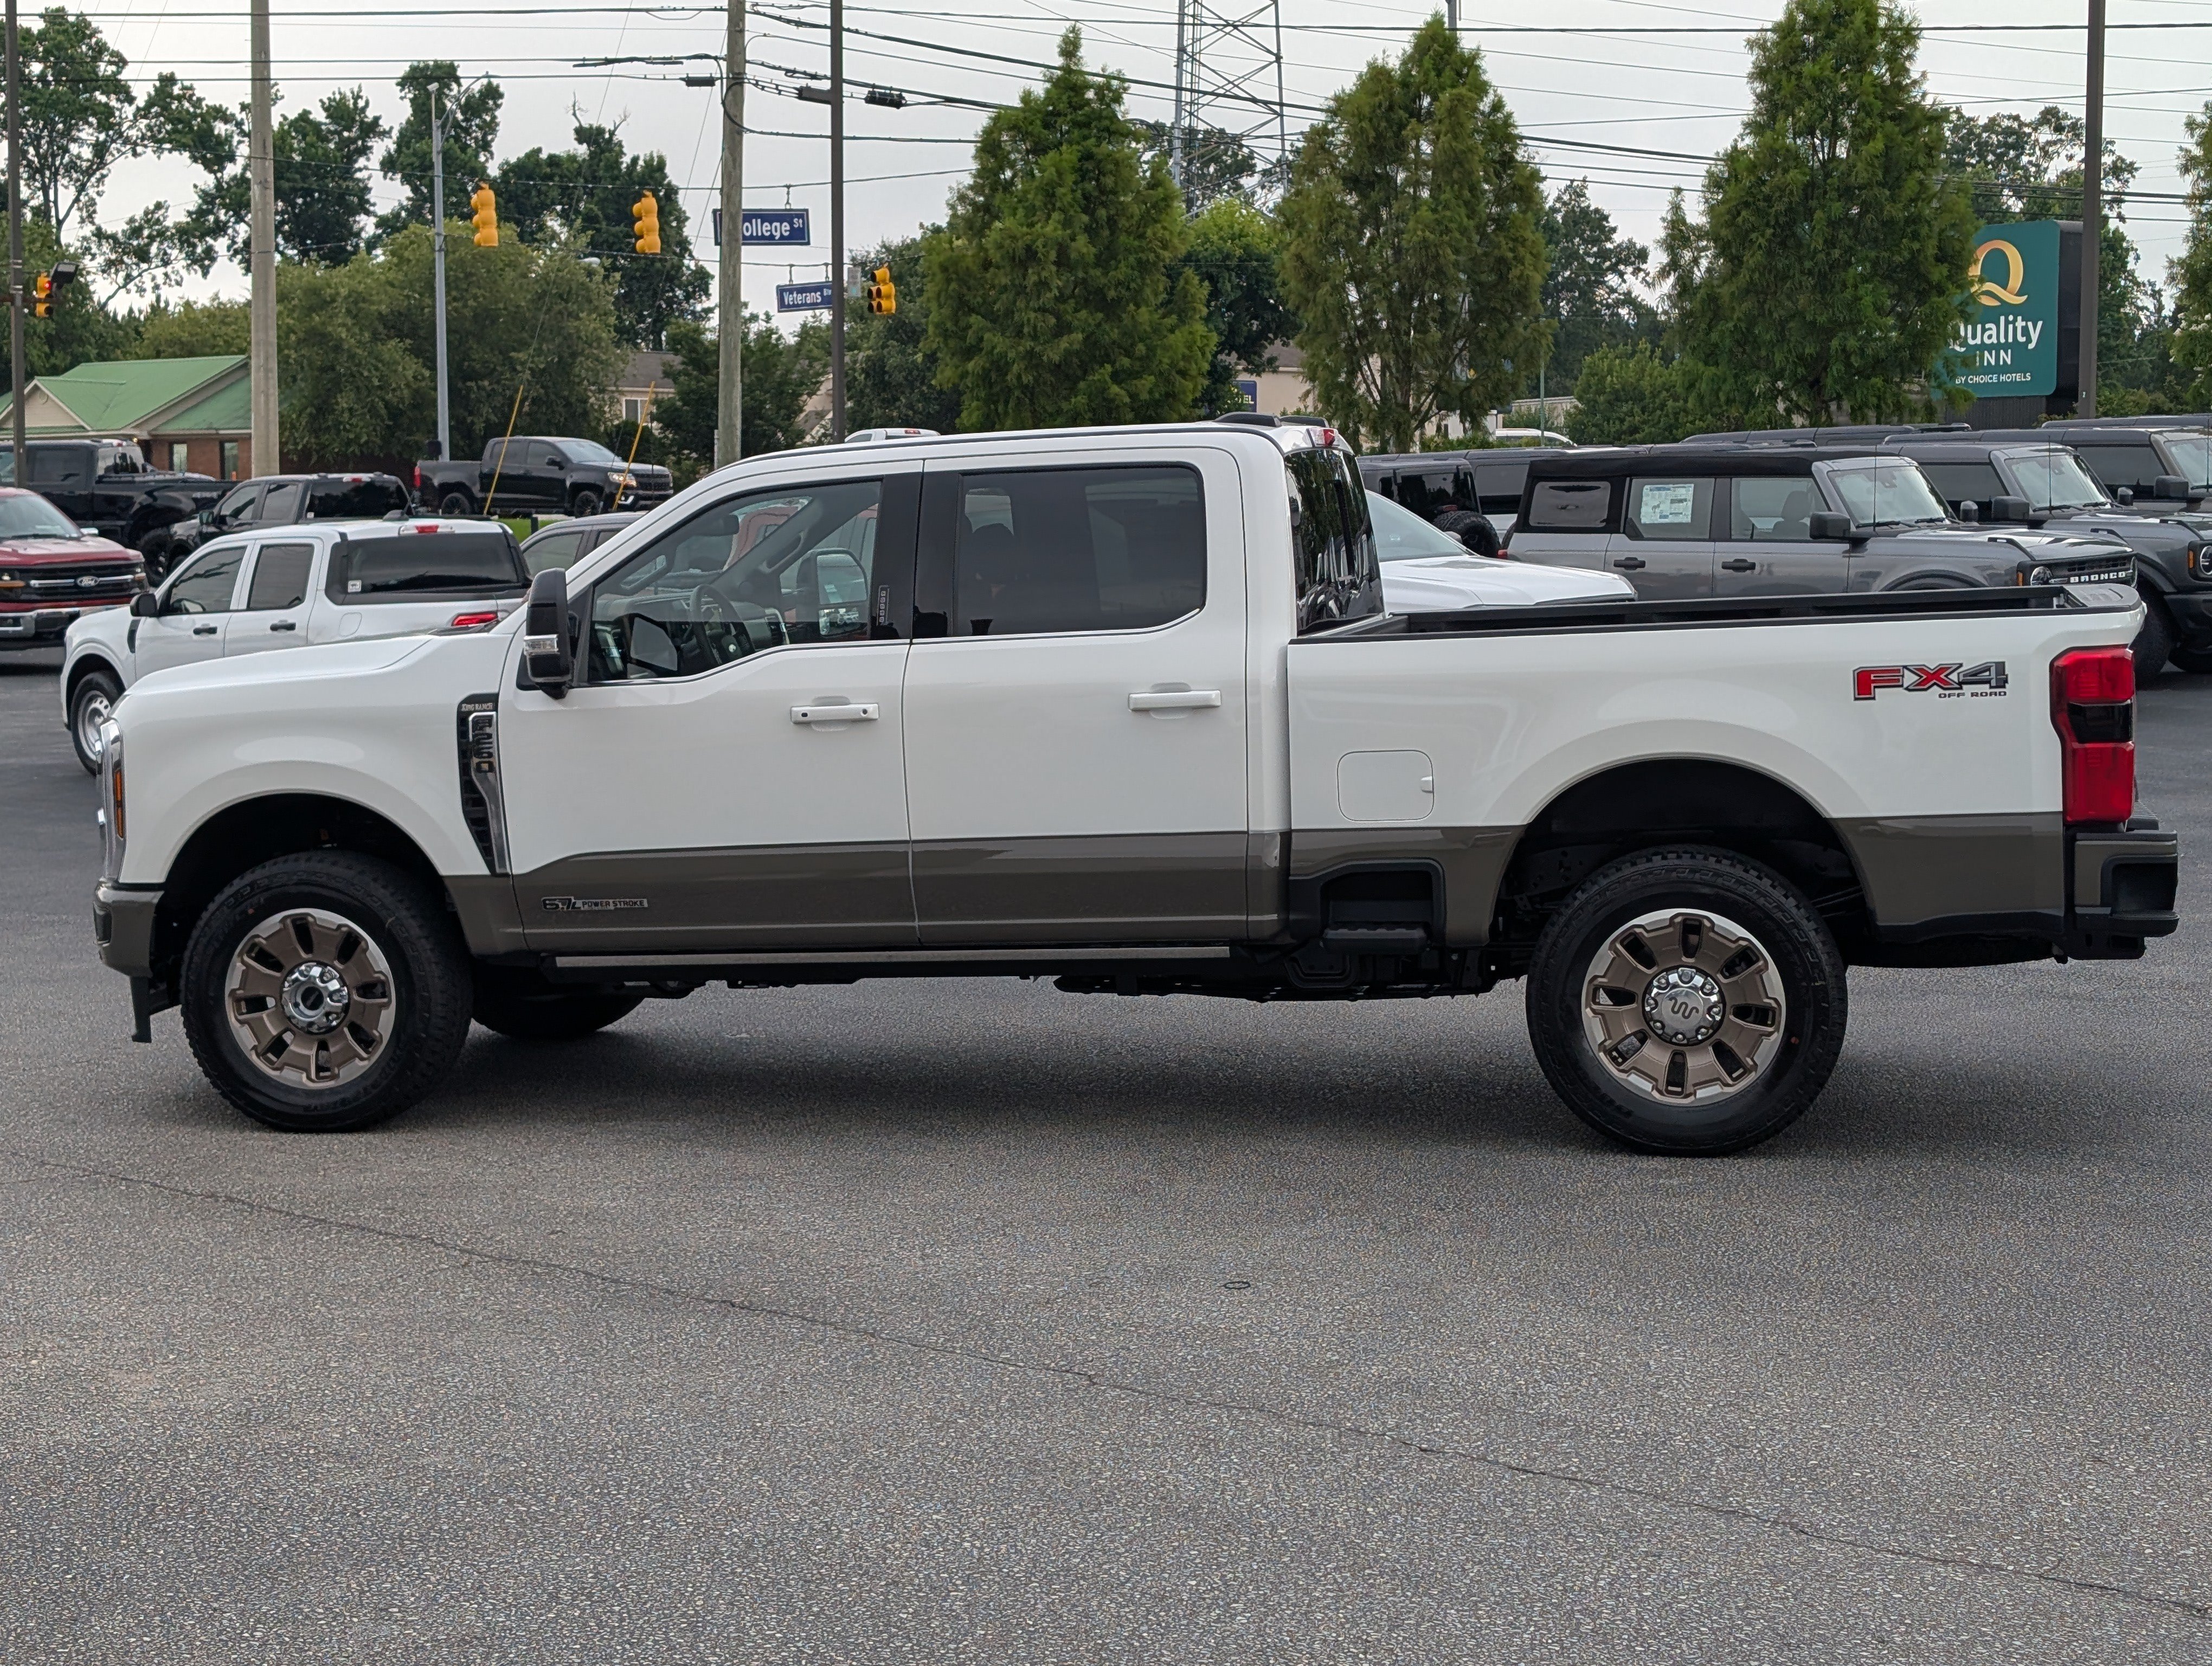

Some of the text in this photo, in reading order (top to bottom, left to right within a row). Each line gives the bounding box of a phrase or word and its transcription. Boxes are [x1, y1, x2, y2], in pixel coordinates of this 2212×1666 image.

[743, 217, 803, 240] ollege St
[783, 291, 822, 305] Veterans
[1976, 349, 2011, 366] INN
[1956, 373, 2031, 384] BY CHOICE HOTELS
[80, 576, 97, 586] Ford
[2069, 571, 2126, 583] BRONCO
[1853, 661, 2009, 701] FX4
[612, 899, 645, 908] STROKE
